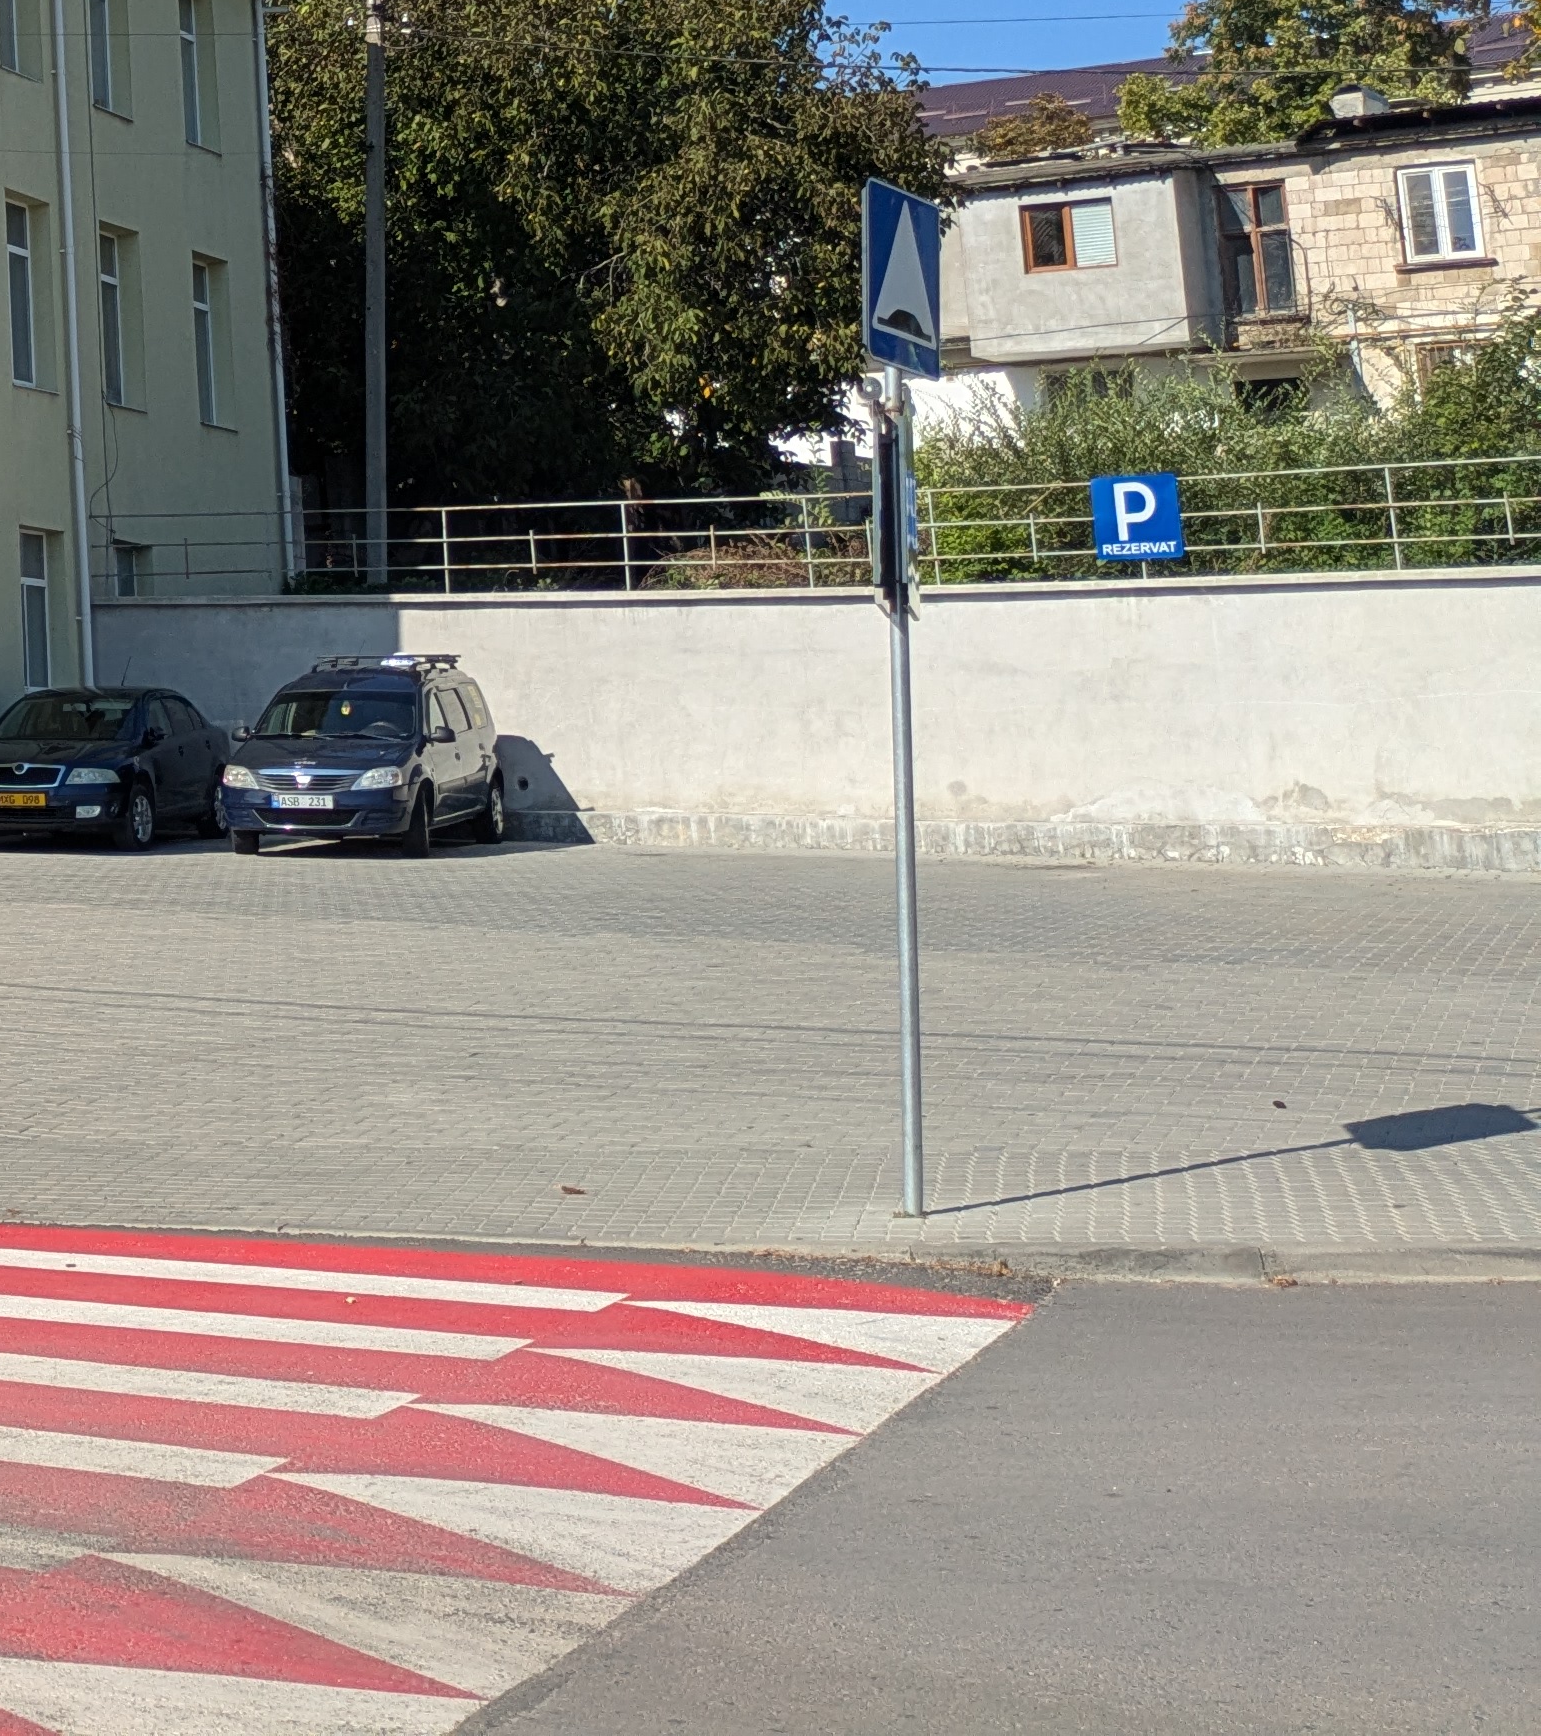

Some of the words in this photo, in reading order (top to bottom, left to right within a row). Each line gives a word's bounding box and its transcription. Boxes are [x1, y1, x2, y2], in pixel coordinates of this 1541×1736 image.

[1113, 481, 1156, 542] P
[1102, 541, 1177, 556] REZERVAT
[280, 796, 300, 807] ASB
[308, 797, 327, 807] 231
